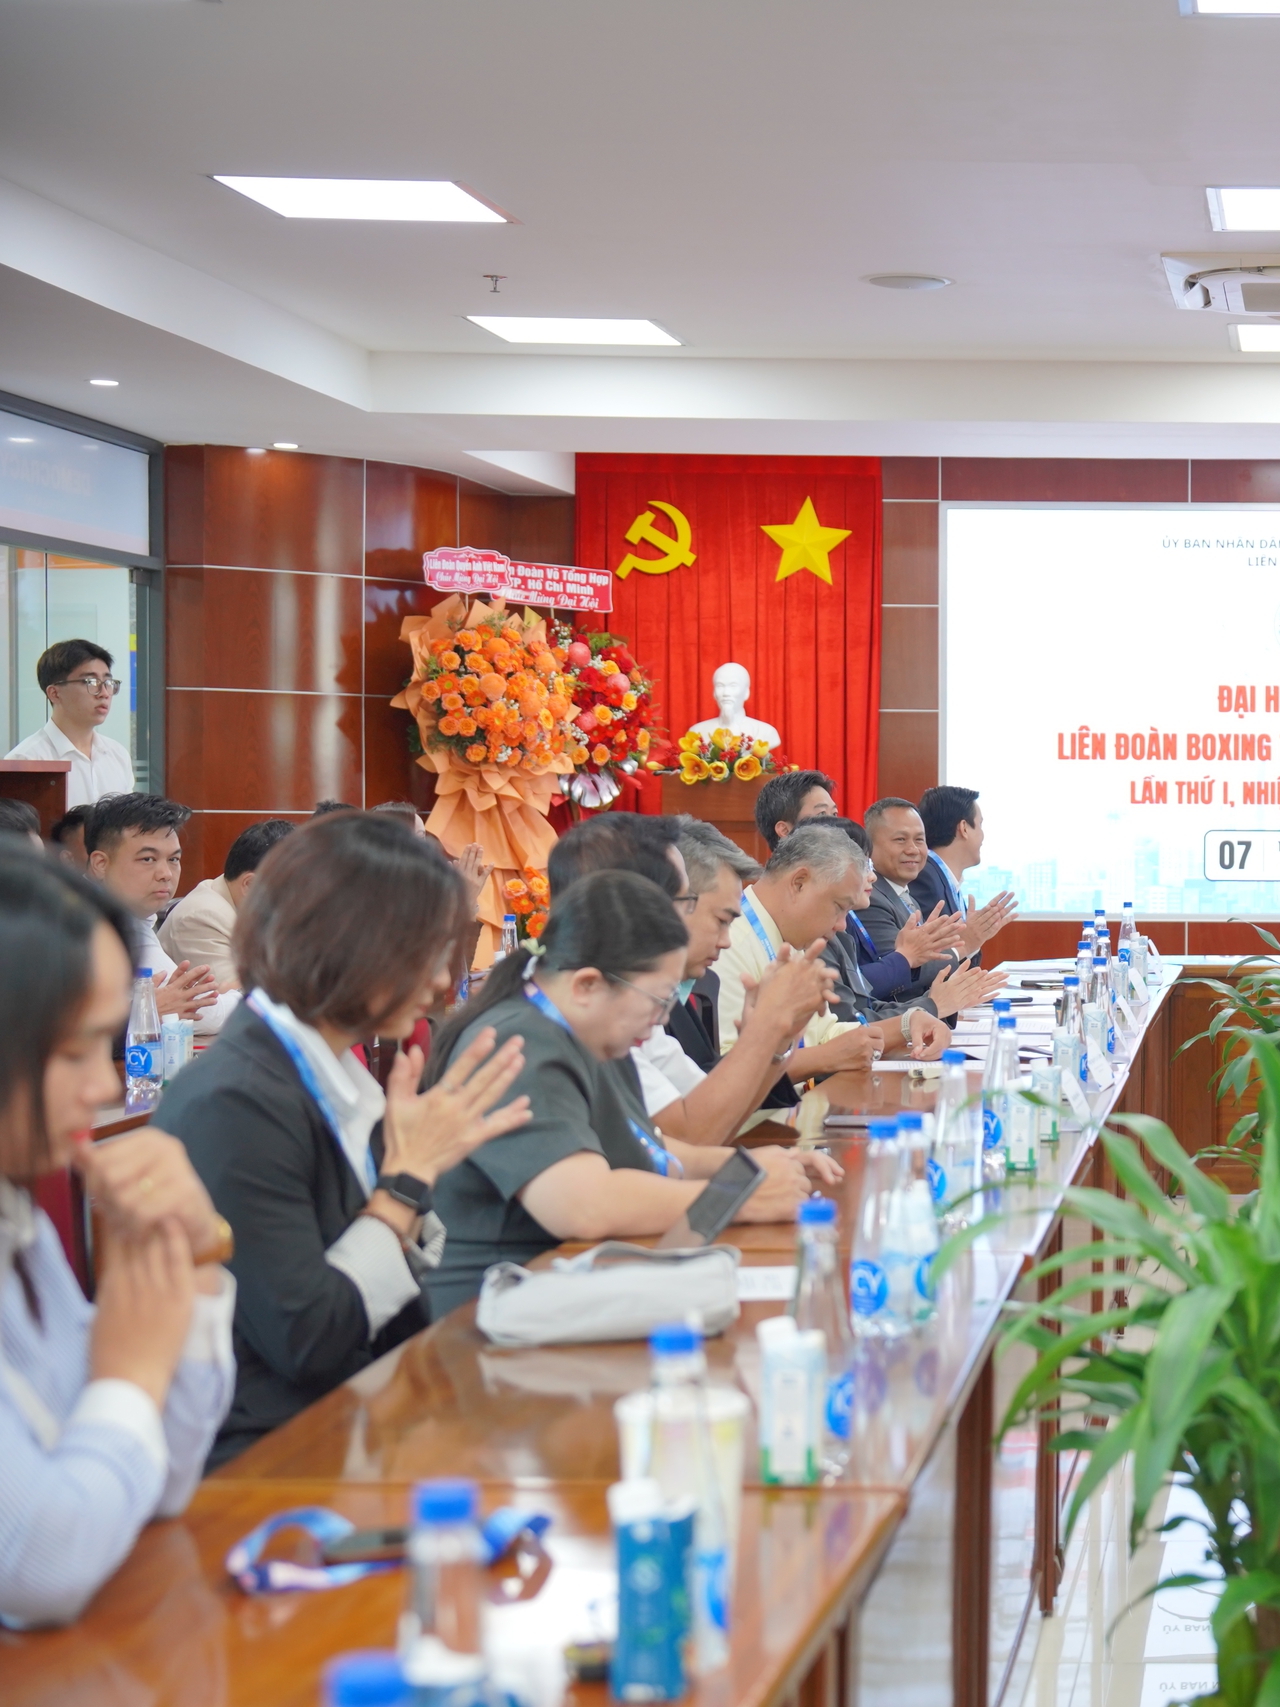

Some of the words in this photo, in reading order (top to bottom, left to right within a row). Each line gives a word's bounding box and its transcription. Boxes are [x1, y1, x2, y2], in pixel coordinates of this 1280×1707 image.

[1184, 539, 1211, 548] BAN
[1216, 537, 1255, 548] NHÂN
[494, 562, 506, 572] Nam
[1248, 554, 1277, 566] LIÊN
[517, 565, 544, 578] Đoàn
[546, 568, 559, 579] Võ
[562, 569, 586, 584] Tổng
[588, 573, 609, 586] Hợp
[510, 578, 525, 589] TP.
[528, 578, 542, 590] Hồ
[545, 580, 563, 592] Chí
[566, 583, 594, 595] Minh
[528, 591, 555, 607] Mừng
[557, 594, 577, 608] Đại
[579, 596, 599, 610] Hội
[1217, 685, 1255, 719] ĐẠI
[1058, 725, 1106, 760] LIÊN
[1114, 726, 1177, 761] ĐOÀN
[1187, 733, 1271, 761] BOXING
[1130, 775, 1167, 804] LẦN
[1175, 775, 1215, 805] THỨ
[1223, 781, 1235, 807] I,
[1219, 840, 1252, 870] 07
[127, 1052, 148, 1066] ICY
